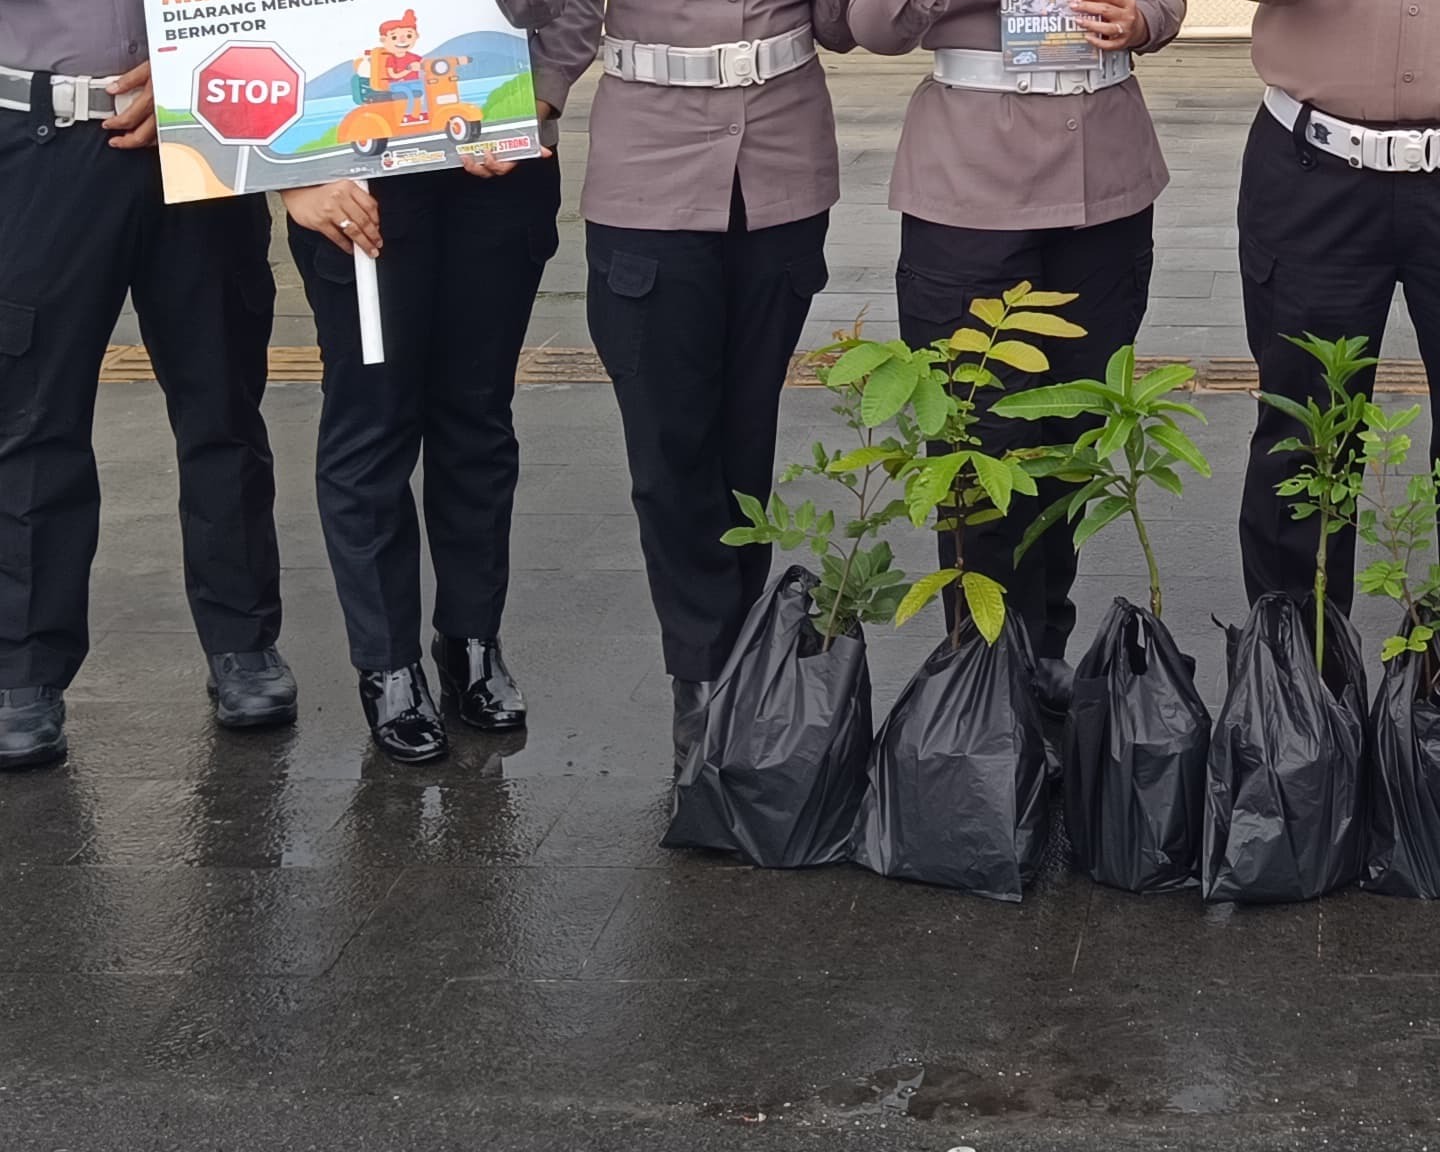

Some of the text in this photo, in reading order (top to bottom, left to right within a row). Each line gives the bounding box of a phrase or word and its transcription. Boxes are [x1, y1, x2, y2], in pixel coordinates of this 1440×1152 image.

[163, 1, 257, 23] DILARANG
[165, 18, 267, 41] BERMOTOR
[1008, 16, 1061, 34] OPERASI
[206, 78, 291, 104] STOP
